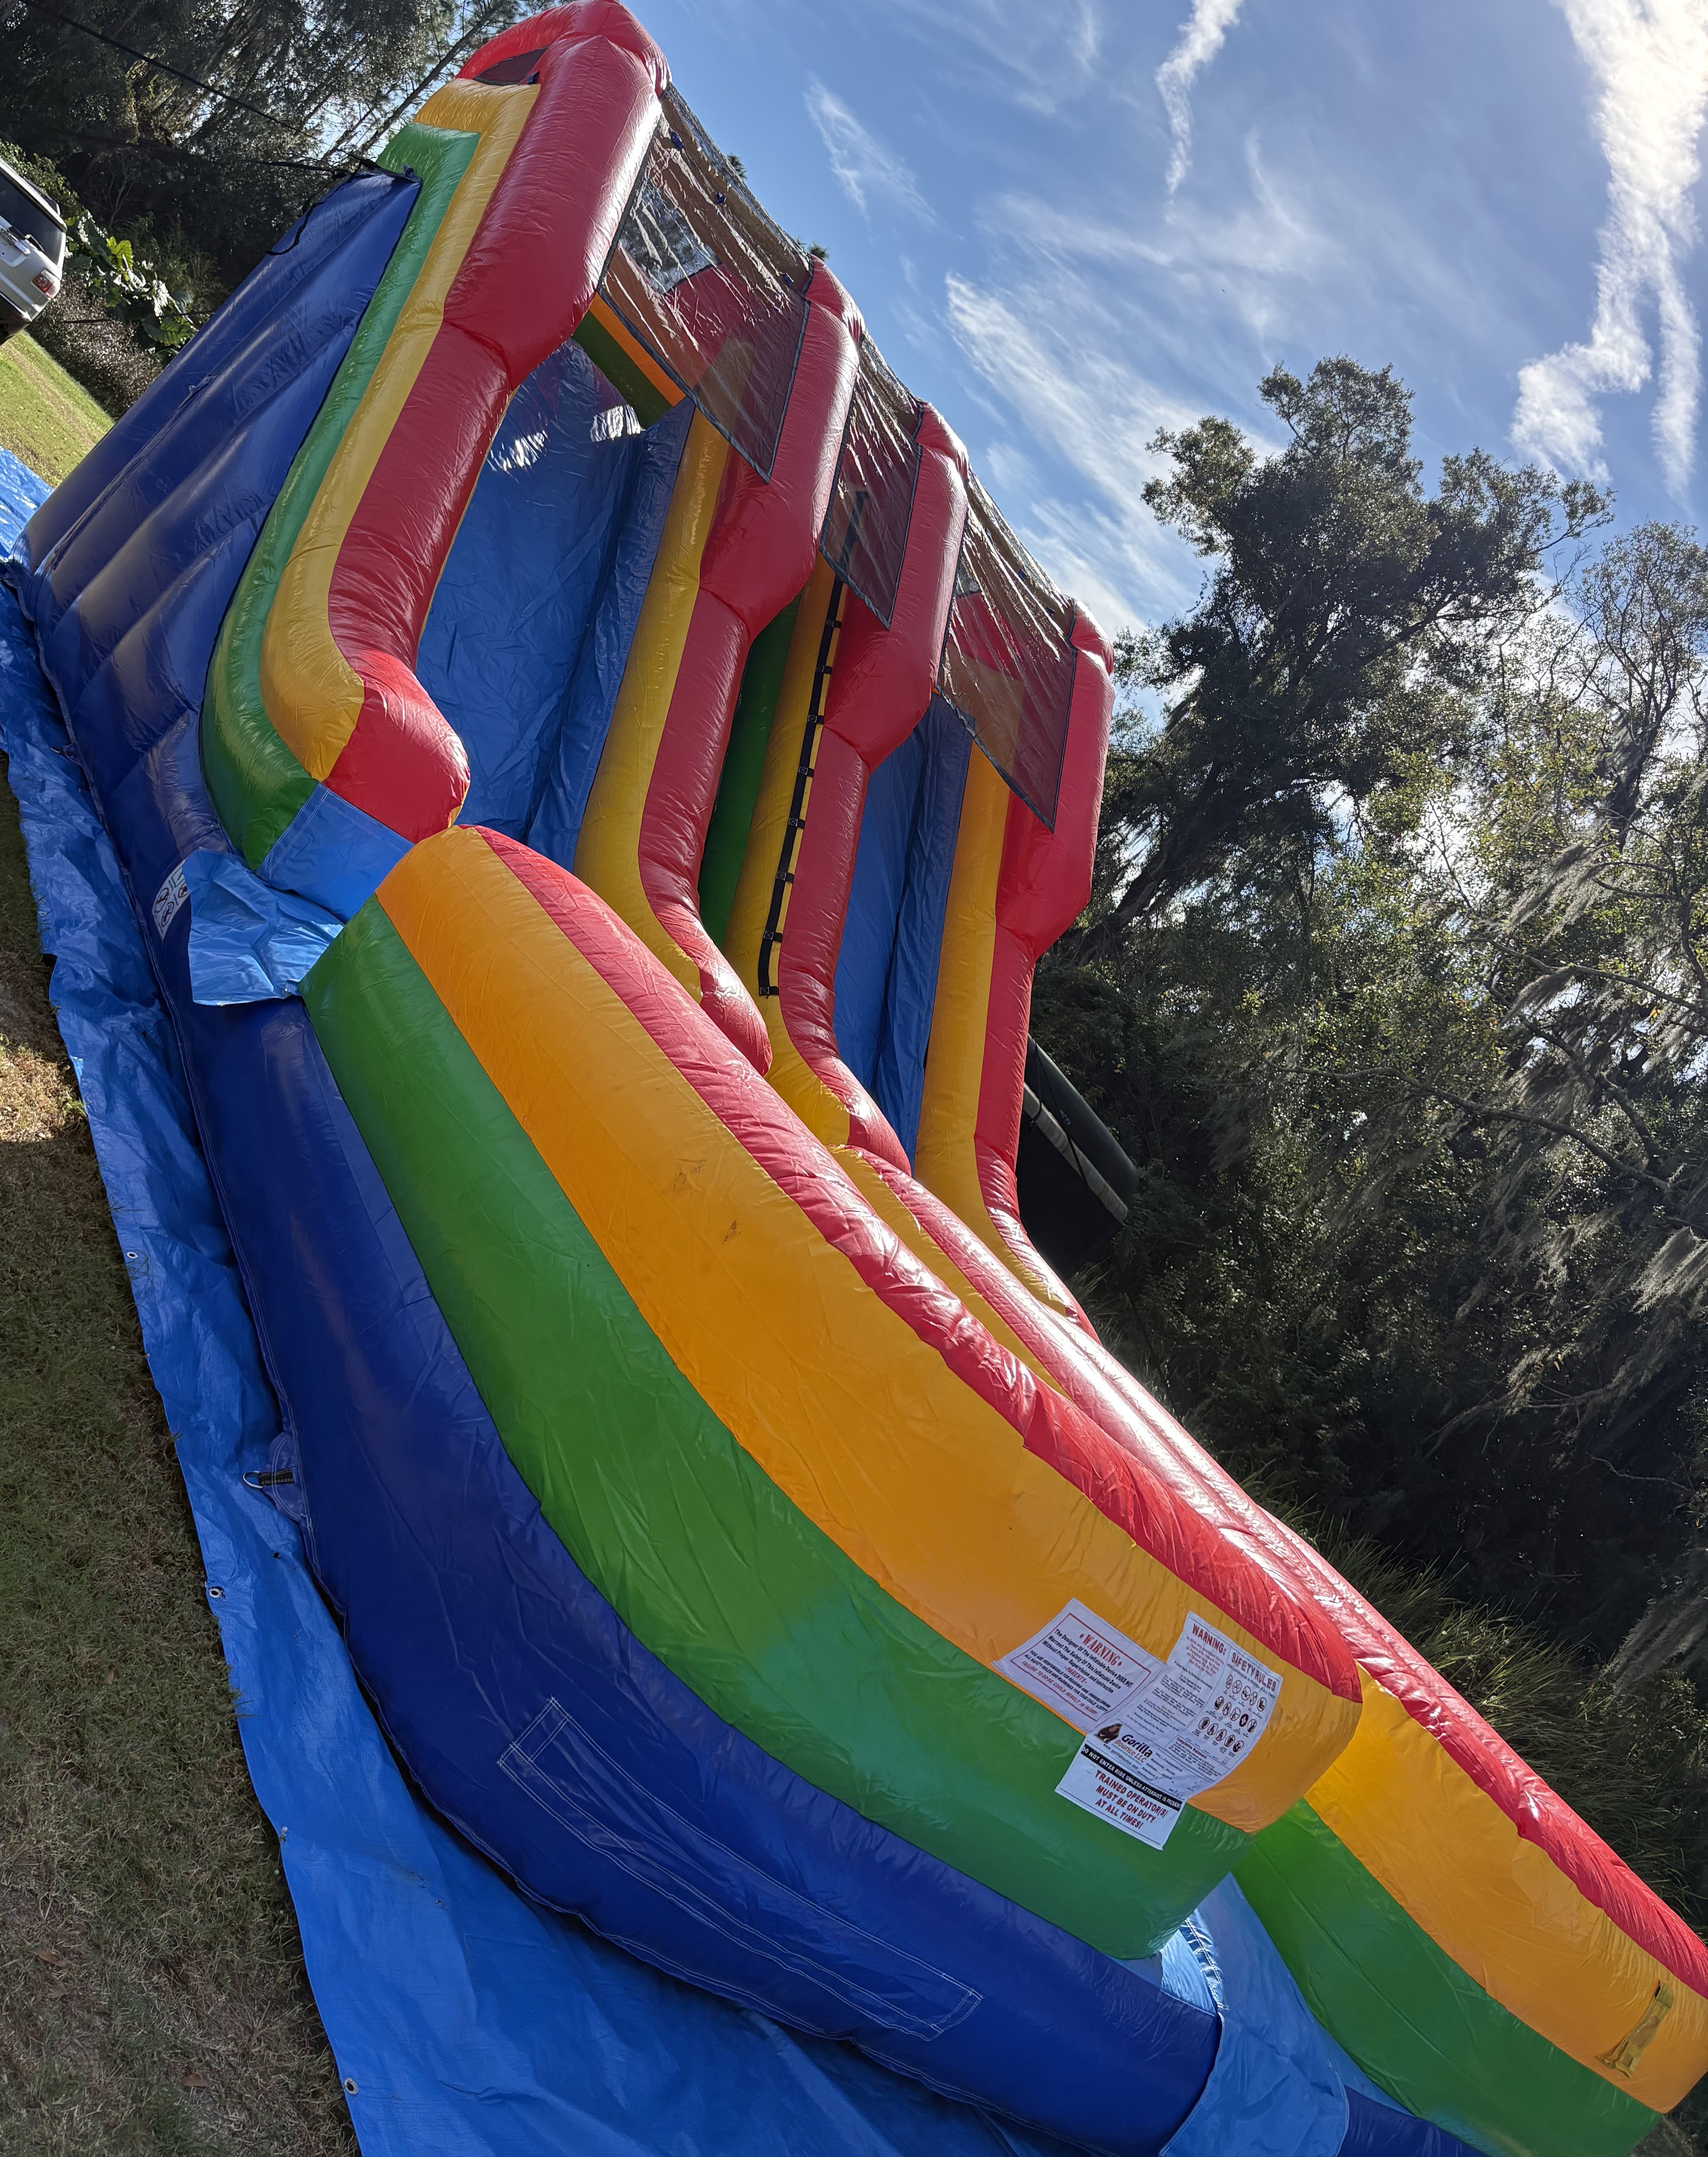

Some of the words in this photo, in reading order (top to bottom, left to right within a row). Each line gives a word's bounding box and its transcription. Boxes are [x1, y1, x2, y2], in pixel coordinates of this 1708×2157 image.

[1061, 1634, 1079, 1648] Designer
[1089, 1654, 1106, 1669] Inflatable
[1105, 1666, 1117, 1677] Device
[1082, 1634, 1121, 1665] WARNING
[1192, 1624, 1226, 1655] WARNING:
[1021, 1661, 1037, 1671] FAILURE
[1042, 1640, 1058, 1653] Without
[1056, 1650, 1069, 1661] Proper
[1068, 1659, 1089, 1676] Supervision
[1048, 1635, 1064, 1648] Warrant
[1069, 1651, 1082, 1662] Safety
[1086, 1662, 1094, 1671] This
[1093, 1668, 1111, 1682] Inflatable
[1109, 1679, 1121, 1689] Device
[1232, 1653, 1255, 1676] SAFETY
[1255, 1670, 1276, 1692] RULES
[1114, 1740, 1135, 1756] Bounce
[1135, 1752, 1147, 1763] LLC
[1121, 1735, 1153, 1758] Gorilla
[1089, 1752, 1100, 1760] NOT
[1099, 1759, 1115, 1771] ENTER
[1114, 1768, 1125, 1778] RIDE
[1125, 1775, 1142, 1788] UNLESS
[1141, 1786, 1162, 1799] ATTENDANT
[1095, 1770, 1127, 1794] TRAINED
[1126, 1790, 1168, 1818] OPERATOR(S)
[1096, 1784, 1118, 1801] MUST
[1116, 1797, 1128, 1808] BE
[1126, 1803, 1139, 1814] ON
[1137, 1809, 1156, 1823] DUTY
[1095, 1798, 1107, 1808] AT
[1105, 1804, 1119, 1816] ALL
[1119, 1812, 1143, 1829] TIMES!
